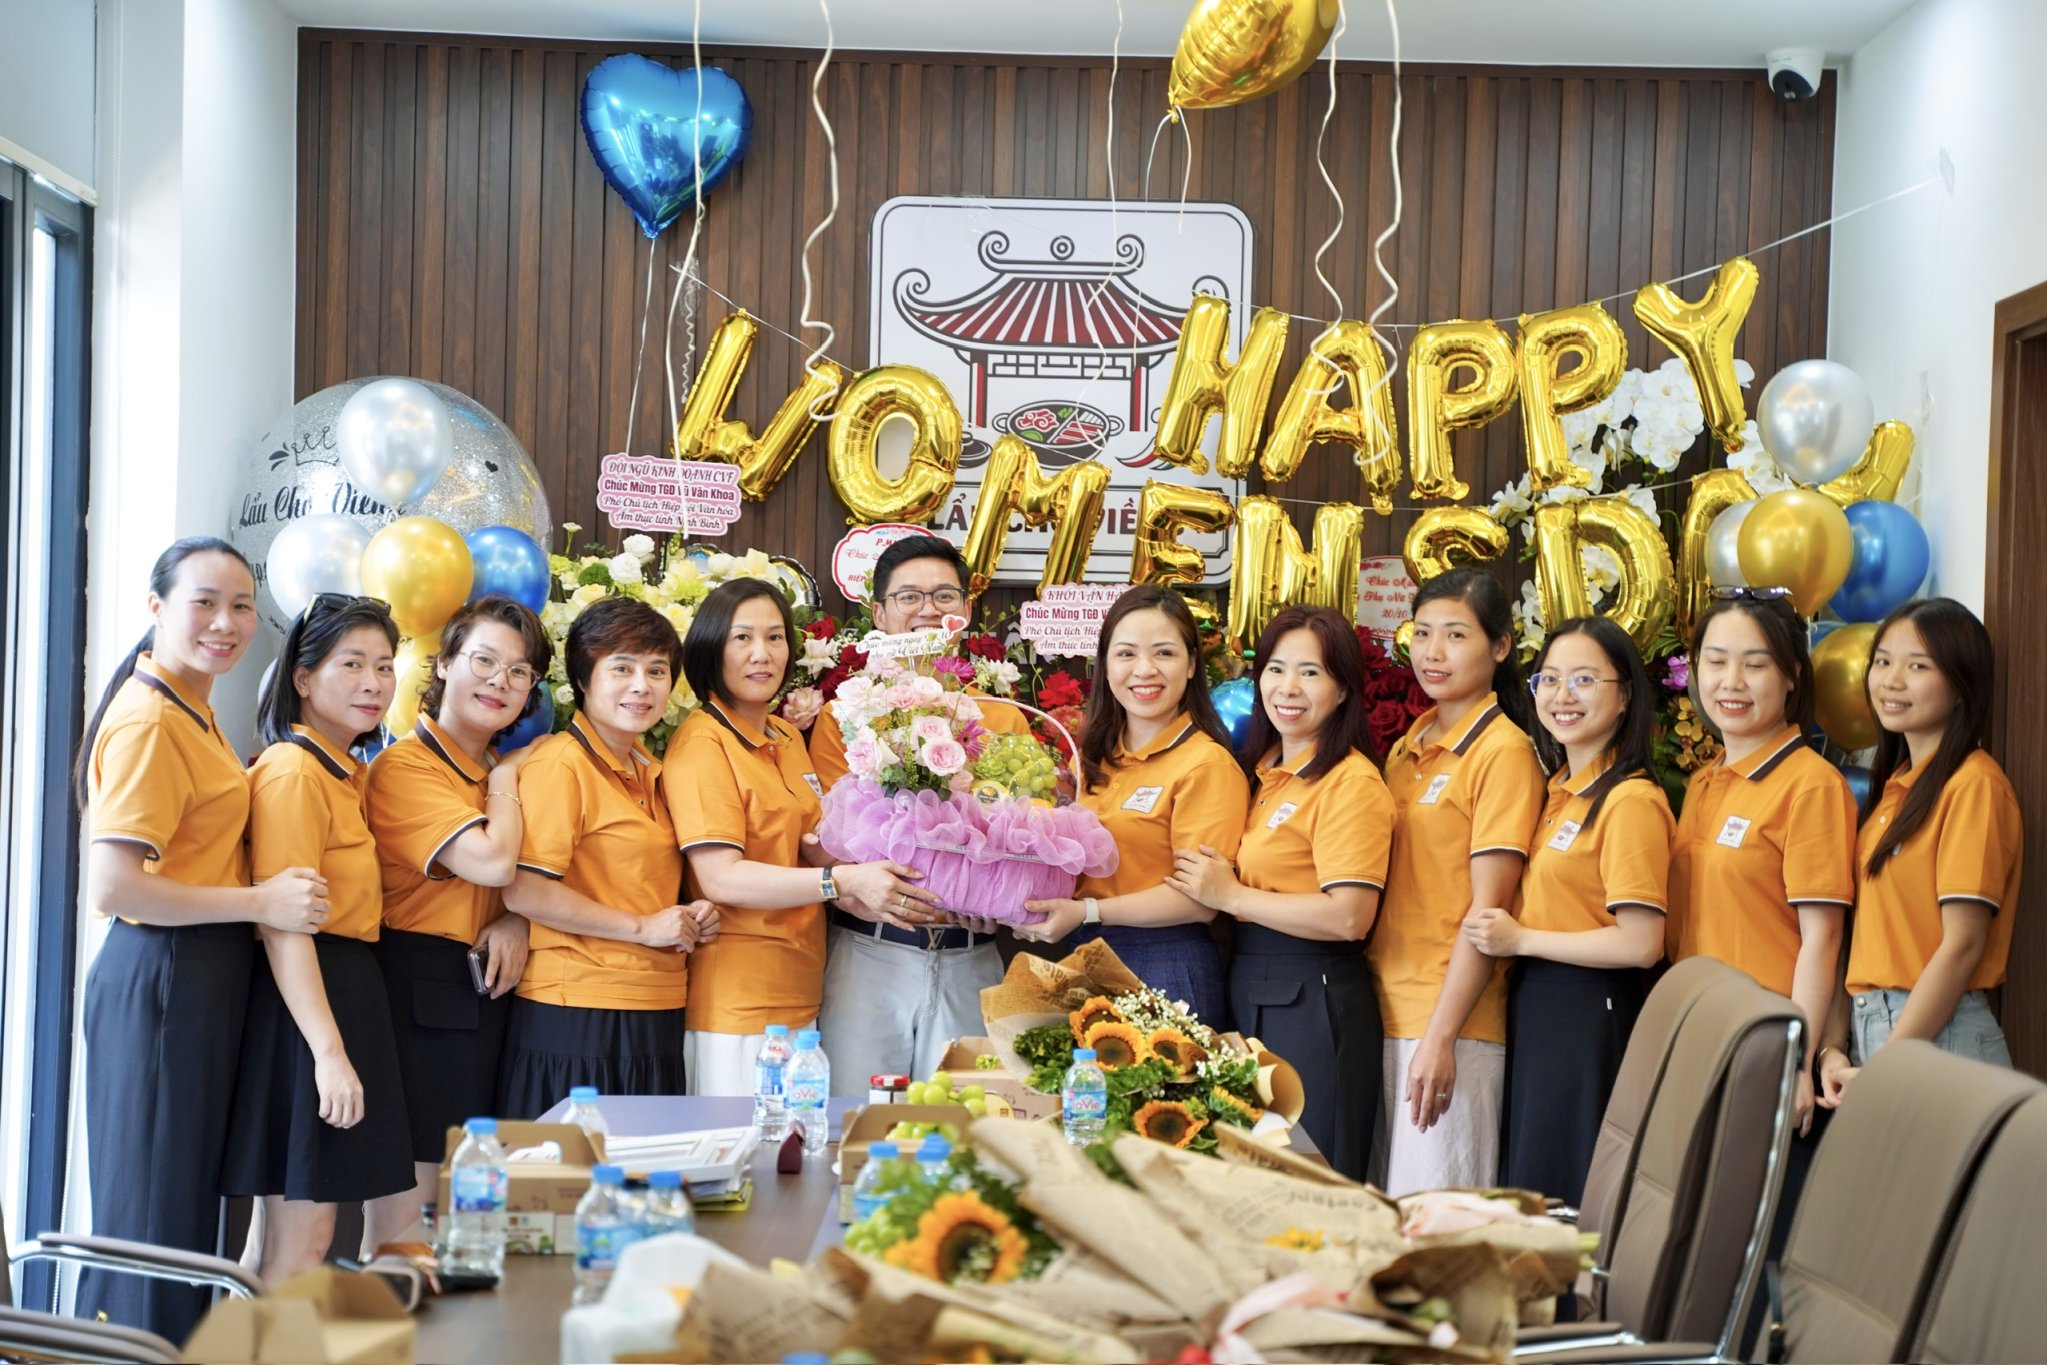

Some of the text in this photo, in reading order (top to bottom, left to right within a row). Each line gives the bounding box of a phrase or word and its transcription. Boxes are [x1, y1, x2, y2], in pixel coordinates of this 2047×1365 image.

[1154, 257, 1759, 515] HAPPY
[651, 465, 677, 478] KINH
[605, 480, 628, 491] Chúc
[630, 481, 656, 495] Mừng
[691, 486, 708, 498] Văn
[711, 490, 735, 500] Khoa
[604, 496, 621, 506] Phó
[642, 499, 658, 511] tịch
[675, 516, 697, 527] Nnh
[1025, 607, 1049, 619] Chúc
[1052, 606, 1079, 620] Mừng
[1082, 609, 1098, 619] TGĐ
[1024, 625, 1042, 635] Phó
[1063, 626, 1080, 638] tịch
[1084, 626, 1101, 638] Hiệ
